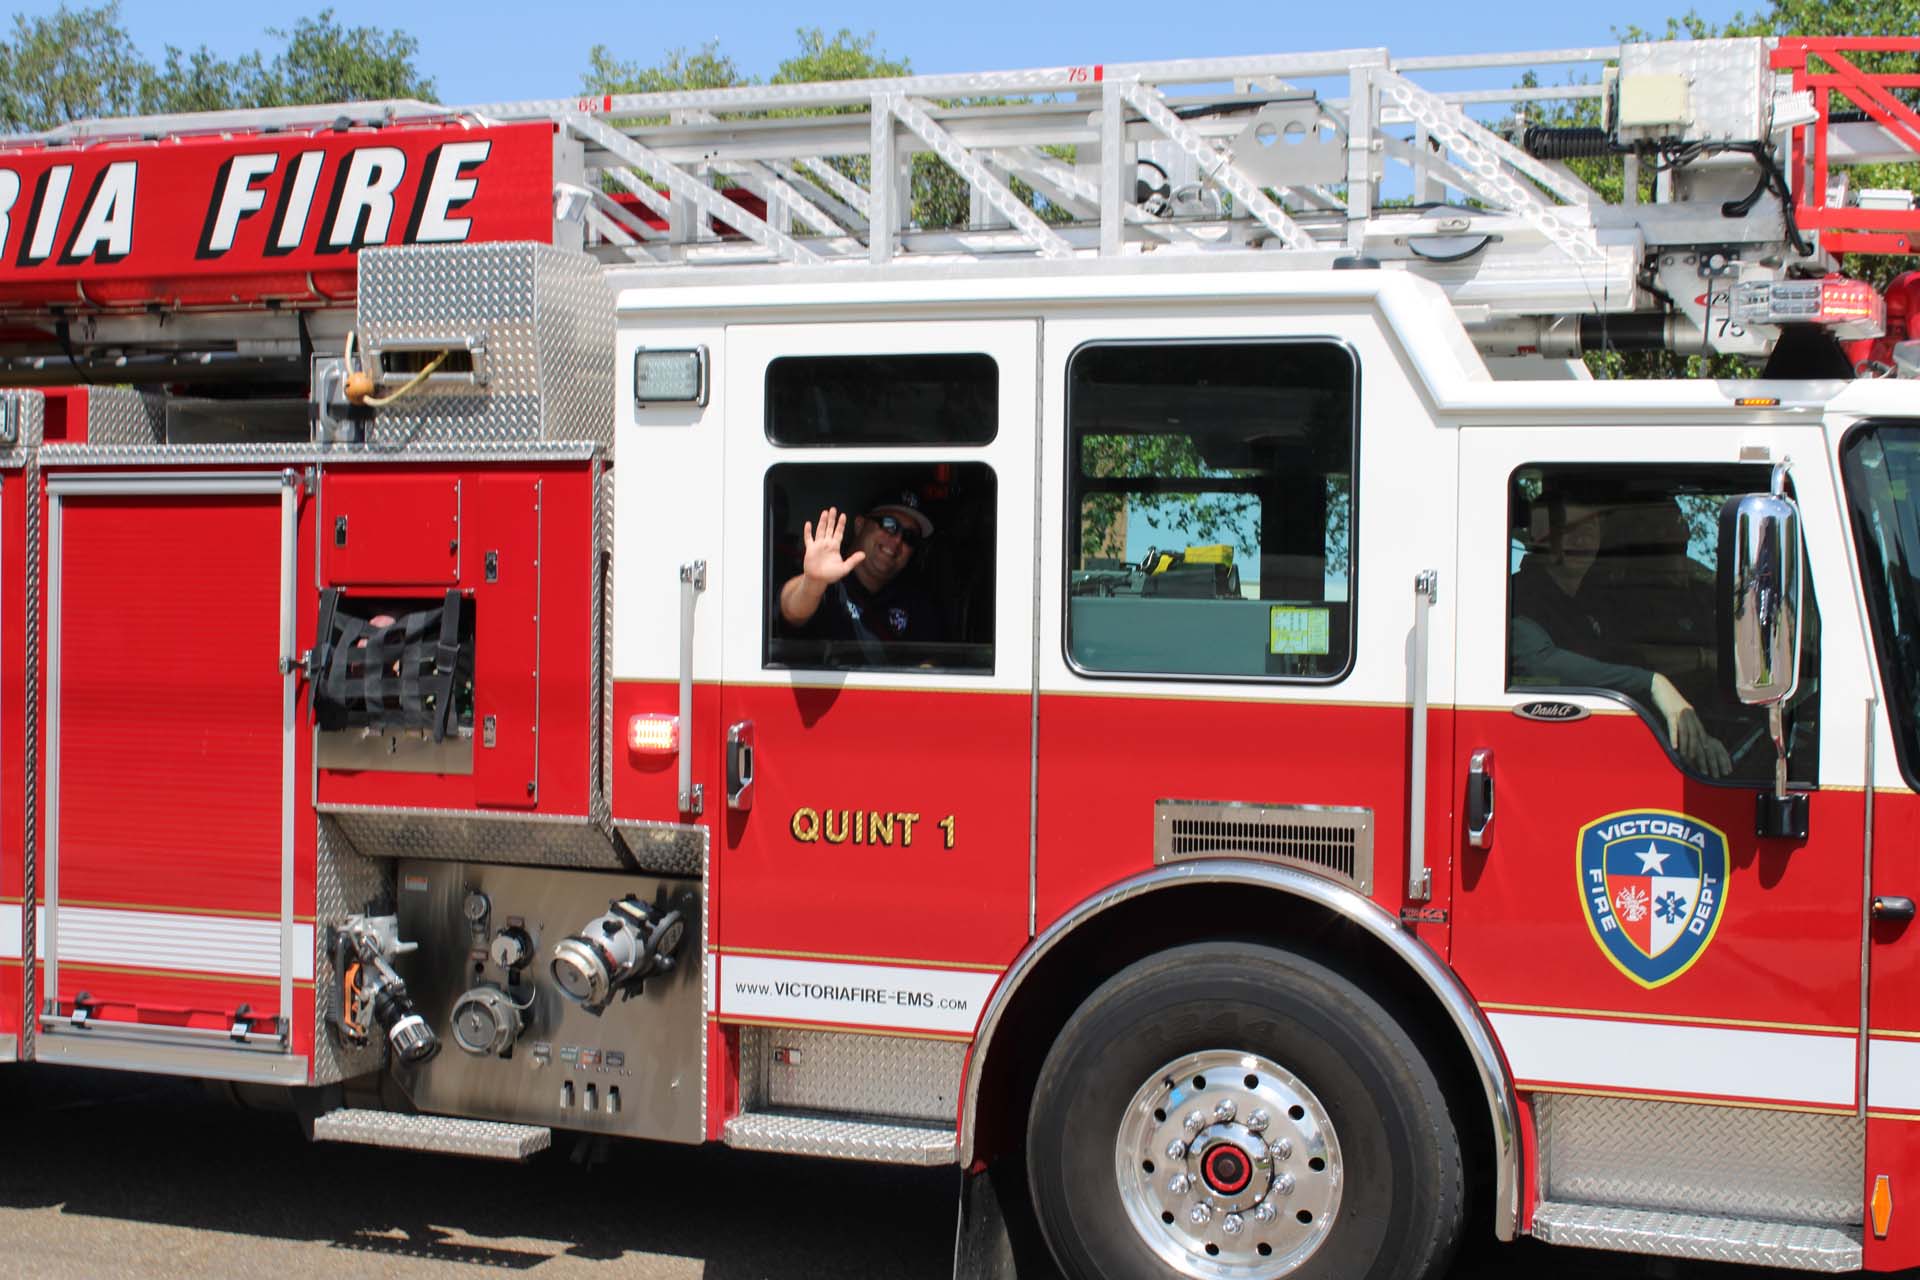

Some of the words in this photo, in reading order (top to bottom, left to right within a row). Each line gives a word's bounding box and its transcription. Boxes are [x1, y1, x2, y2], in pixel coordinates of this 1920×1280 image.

[1068, 66, 1087, 82] 75
[0, 160, 138, 268] IA
[195, 140, 493, 260] FIRE
[790, 807, 920, 848] QUINT
[937, 815, 955, 850] 1
[1597, 819, 1706, 849] VICTORIA
[1589, 868, 1617, 932] FIRE
[1688, 873, 1717, 936] DEPT
